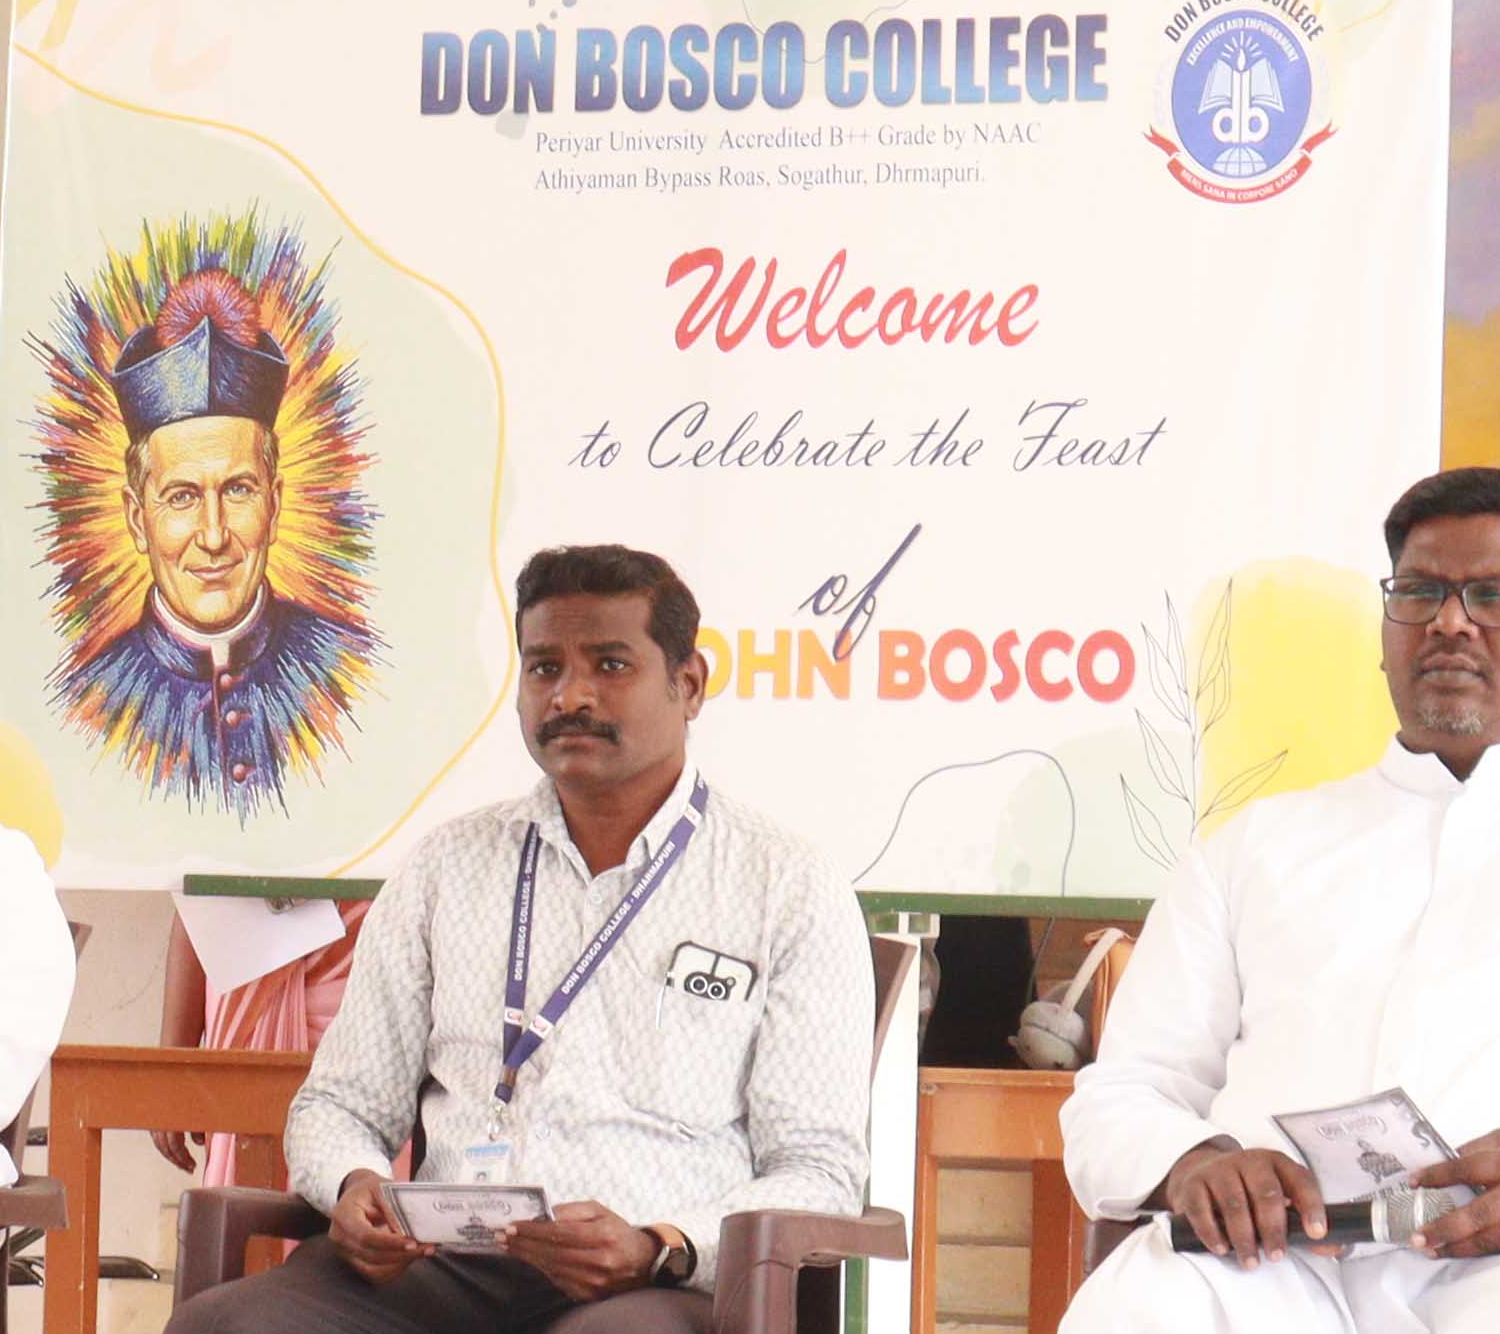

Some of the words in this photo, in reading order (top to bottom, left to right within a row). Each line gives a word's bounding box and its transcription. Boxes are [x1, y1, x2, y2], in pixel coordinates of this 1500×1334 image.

[1164, 2, 1198, 43] DON
[420, 27, 557, 116] DON
[574, 21, 805, 113] BOSCO
[824, 13, 1109, 108] COLLEGE
[535, 131, 604, 157] Periyar
[608, 129, 708, 156] University
[718, 126, 823, 150] Accredited
[829, 126, 871, 148] B++
[878, 124, 938, 147] Grade
[942, 122, 966, 151] by
[972, 121, 1043, 144] NAAC
[535, 166, 640, 195] Athiyaman
[645, 165, 713, 195] Bypass
[718, 165, 771, 191] Roas,
[776, 163, 868, 190] Sogathur,
[875, 160, 986, 189] Dhrmapuri.
[665, 246, 1040, 352] Welcome
[568, 420, 621, 468] to
[646, 401, 886, 469] Celebrate
[894, 407, 984, 468] the
[1013, 398, 1168, 473] Feast
[795, 523, 923, 662] of
[877, 628, 1137, 703] BOSCO
[561, 974, 580, 995] DON
[576, 943, 602, 974] BOSCO
[600, 900, 631, 943] COLLEGE
[631, 840, 676, 899] DHARMAPURI
